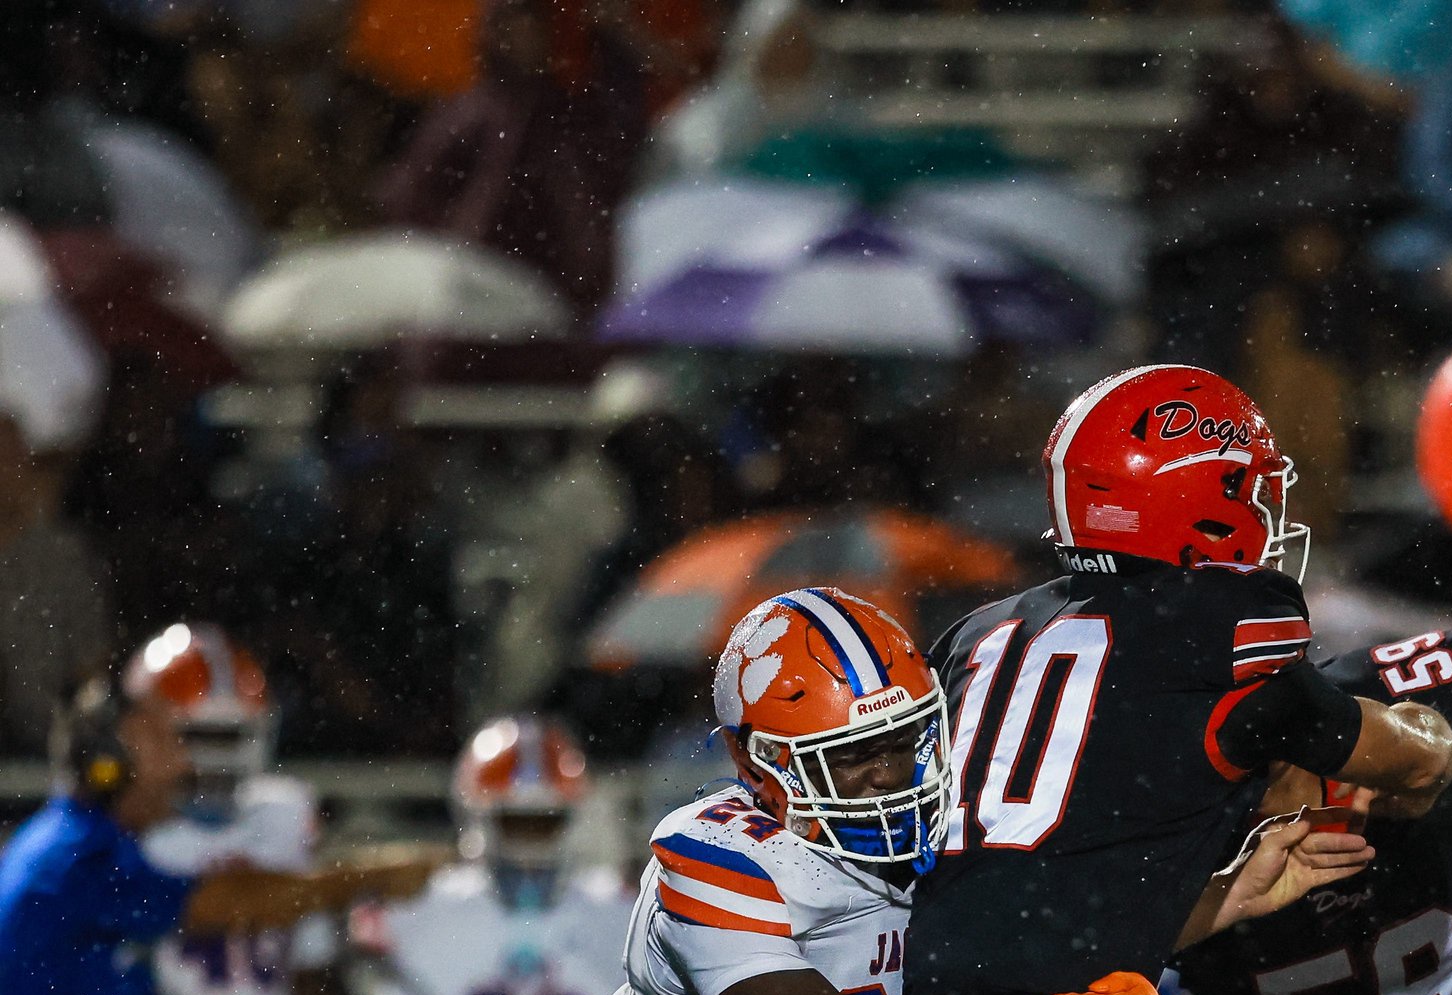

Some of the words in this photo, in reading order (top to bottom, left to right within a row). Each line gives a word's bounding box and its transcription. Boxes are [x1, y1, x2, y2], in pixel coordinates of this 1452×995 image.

[1154, 400, 1252, 457] Dogs
[857, 690, 905, 716] Riddell
[932, 614, 1113, 855] 10
[695, 797, 786, 843] 24
[1312, 887, 1374, 914] Dogs
